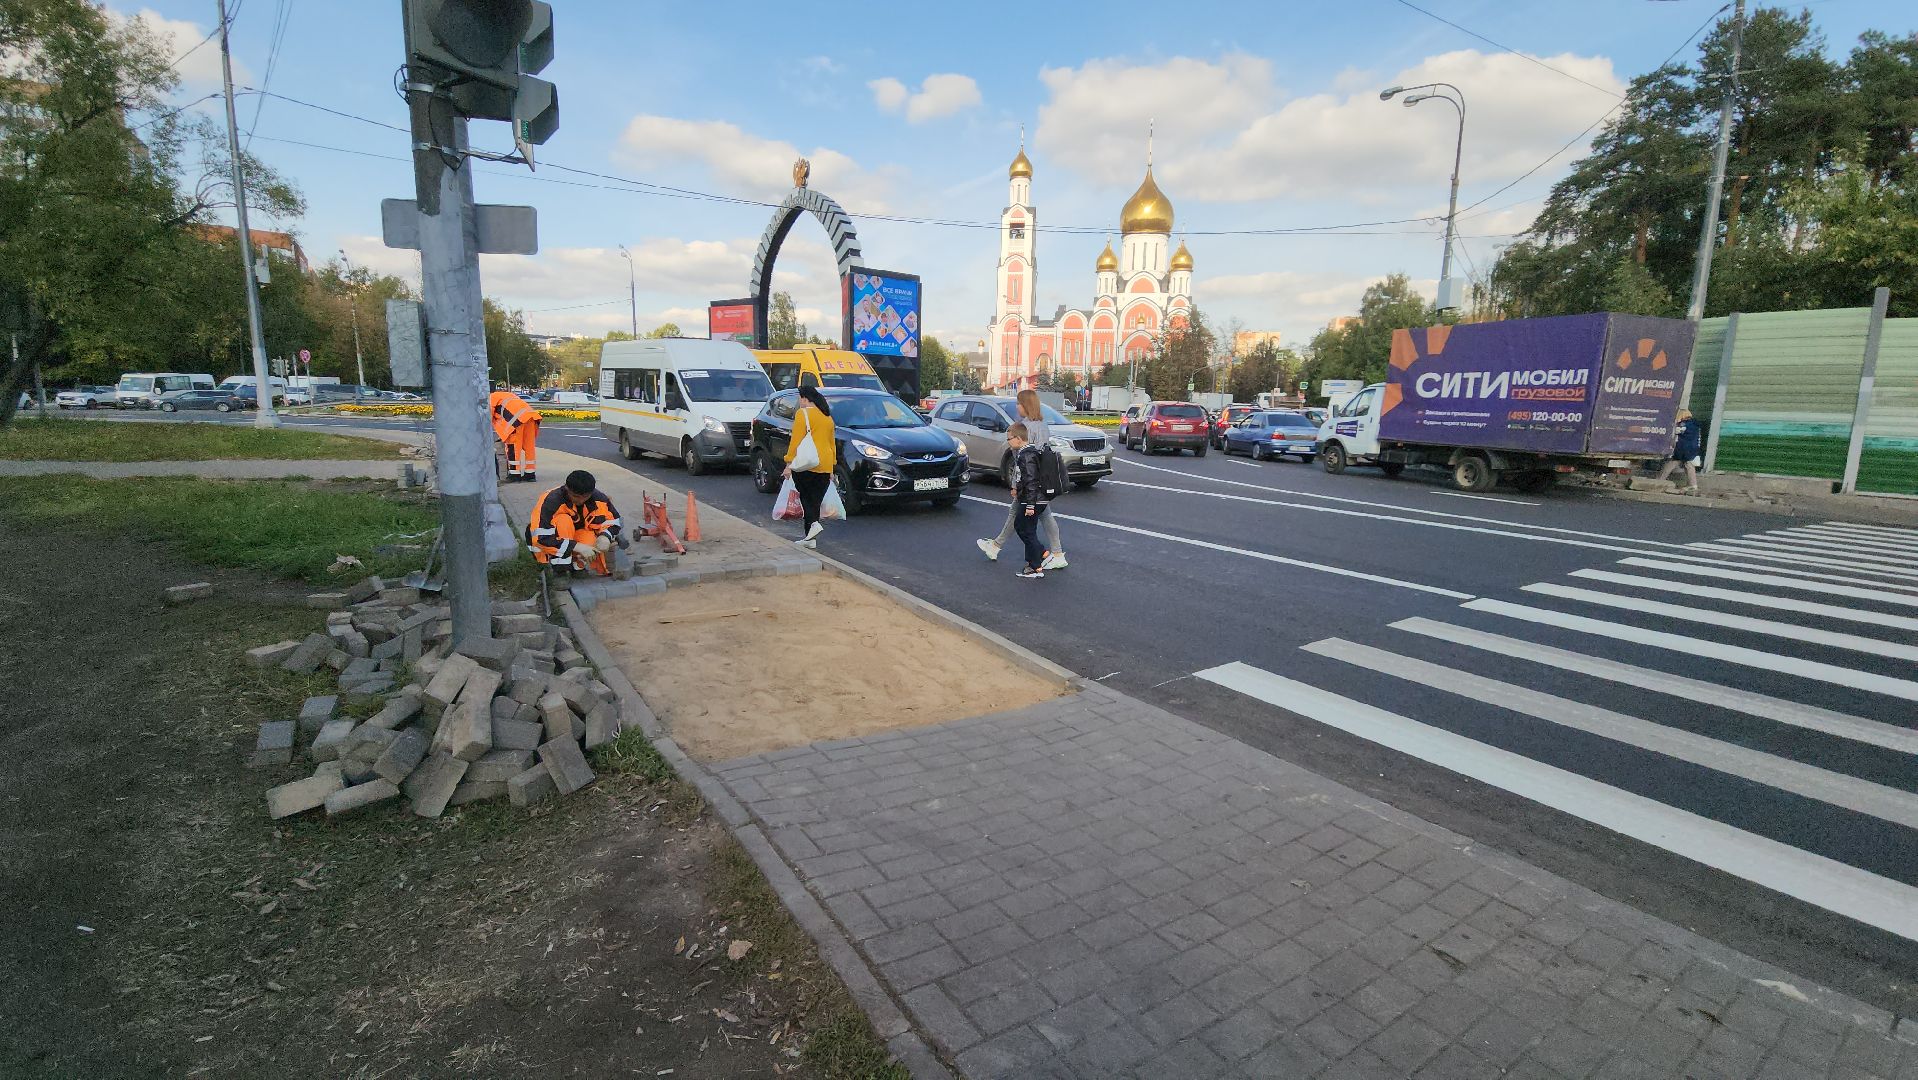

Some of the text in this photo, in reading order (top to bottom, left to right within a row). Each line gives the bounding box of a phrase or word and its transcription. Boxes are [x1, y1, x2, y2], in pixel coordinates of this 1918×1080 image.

[824, 361, 867, 371] ДЕТИ
[1416, 369, 1588, 398] СИТИ МОБИЛ
[1605, 376, 1644, 394] СИТИ
[1645, 380, 1675, 389] МОБИЛ
[1511, 387, 1585, 399] грузовой
[1508, 411, 1582, 422] (495) 120-00-00
